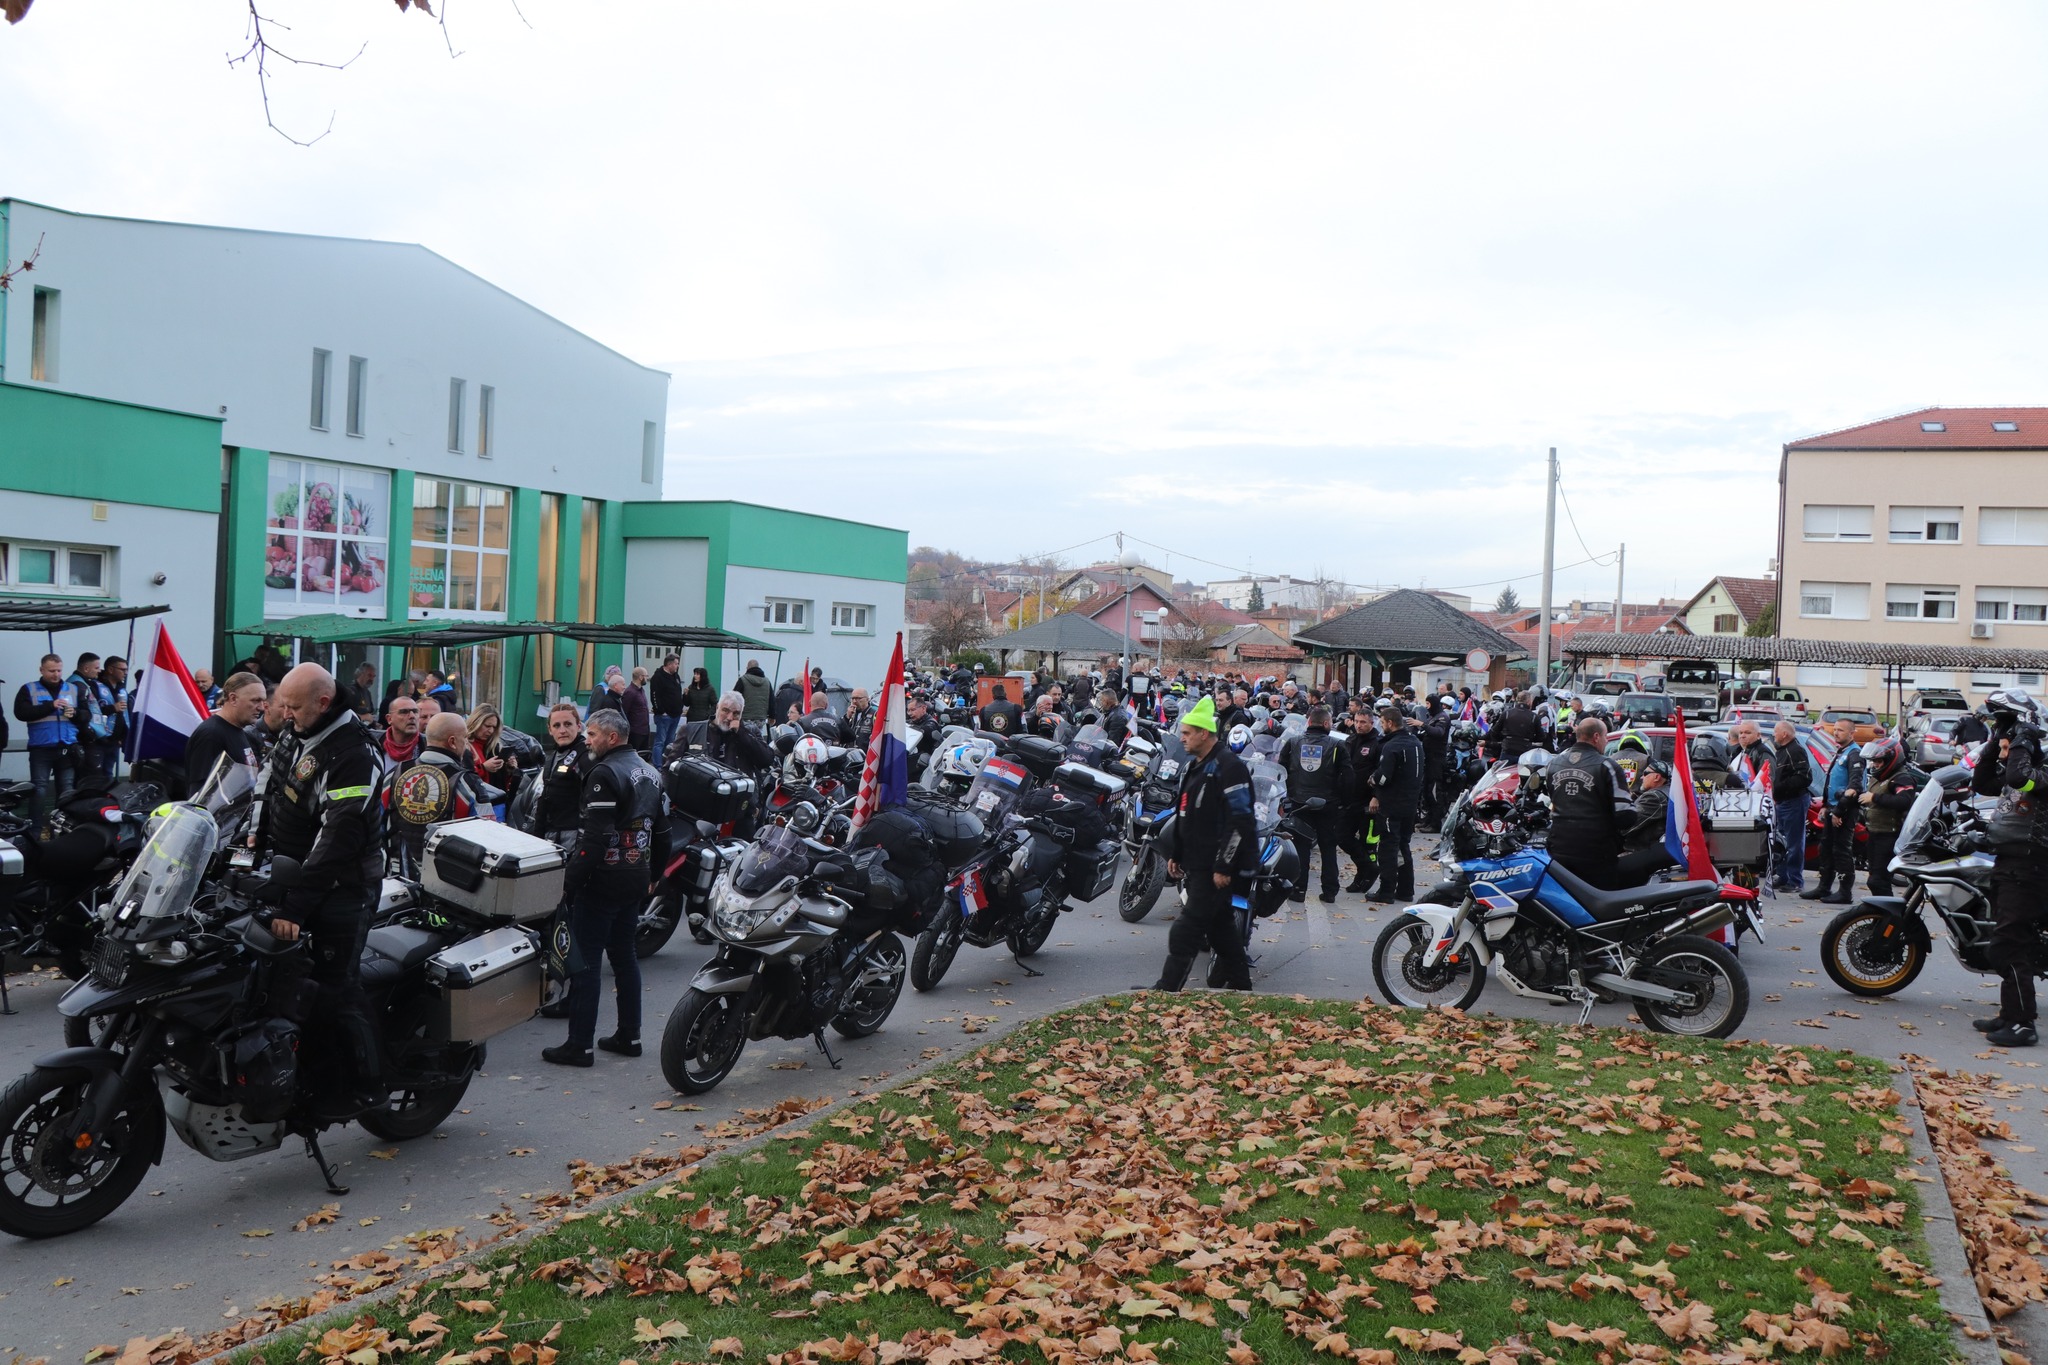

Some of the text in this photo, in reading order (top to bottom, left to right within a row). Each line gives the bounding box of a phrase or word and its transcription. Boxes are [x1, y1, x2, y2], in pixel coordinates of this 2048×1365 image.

[410, 581, 444, 594] RŽNICA
[1556, 770, 1570, 779] Free
[402, 809, 434, 821] HRVATSKA
[1474, 863, 1534, 881] TUAREG
[1624, 904, 1644, 914] aprilia
